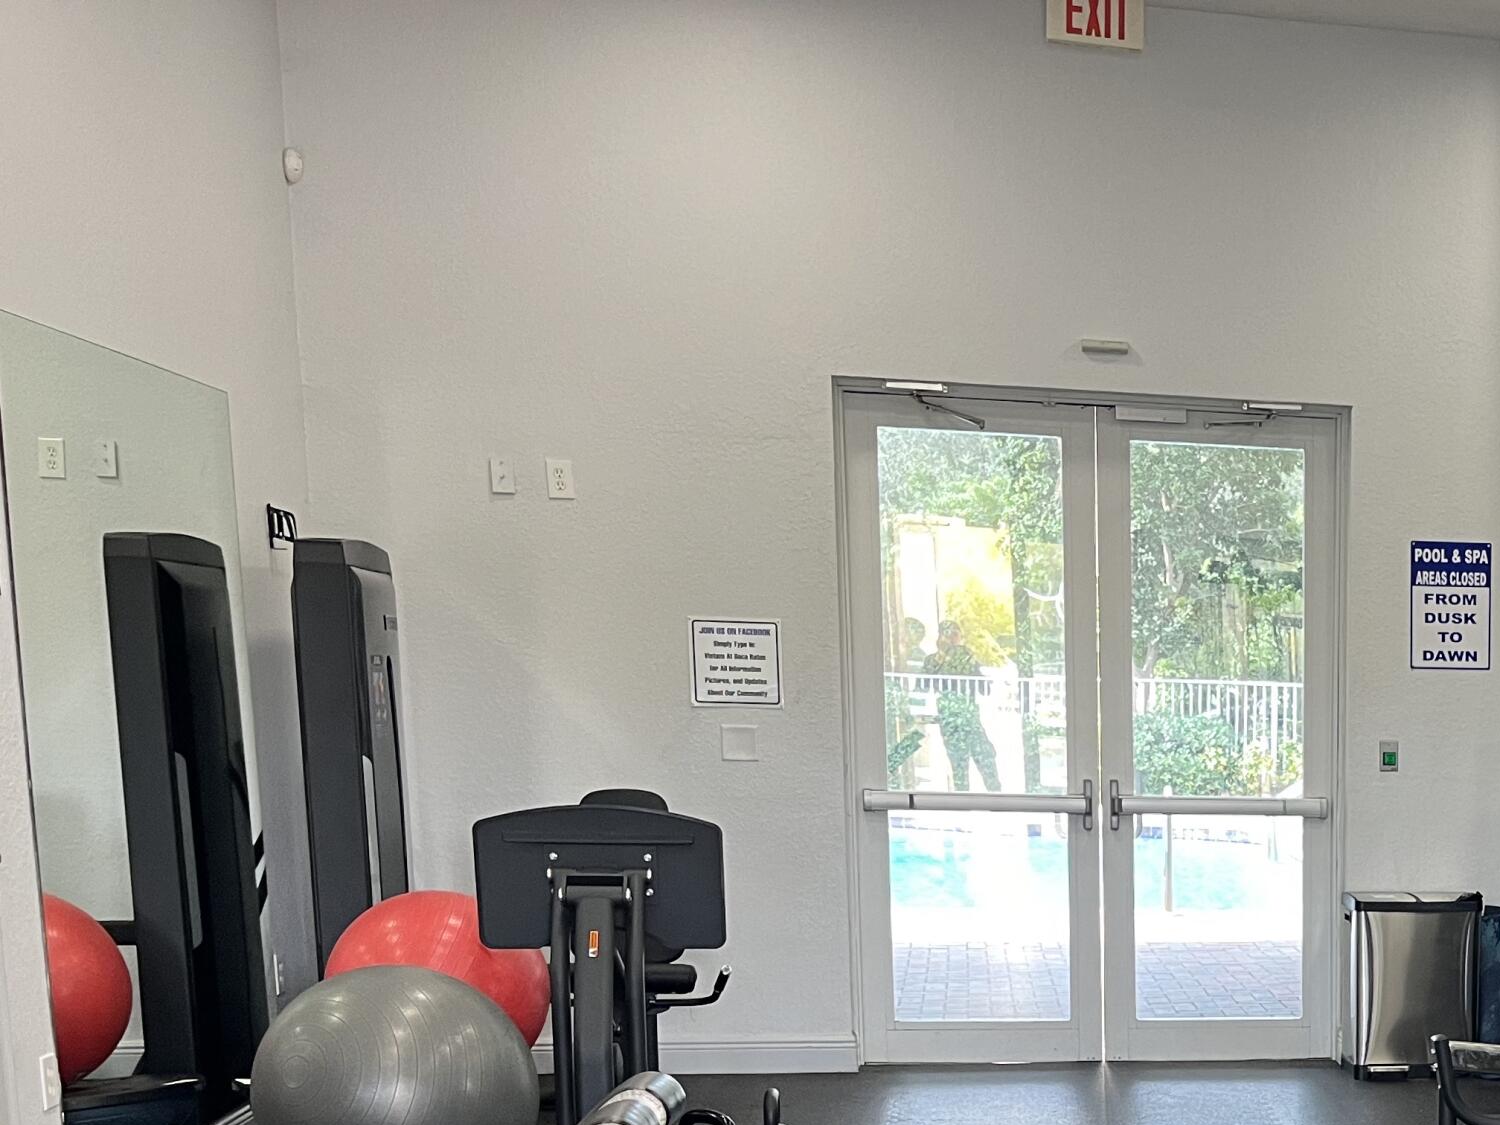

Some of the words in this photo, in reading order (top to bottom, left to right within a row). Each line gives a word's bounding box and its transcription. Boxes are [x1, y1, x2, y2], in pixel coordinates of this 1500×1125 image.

[1066, 0, 1125, 40] EXIT
[1414, 548, 1448, 563] POOL
[1452, 549, 1461, 563] &
[1465, 550, 1489, 564] SPA
[1415, 571, 1447, 585] AREAS
[1449, 572, 1487, 586] CLOSED
[1424, 594, 1477, 605] FROM
[1424, 613, 1477, 624] DUSK
[738, 628, 771, 636] FACEBOOK
[1437, 632, 1463, 643] TO
[1422, 651, 1478, 662] DAWN
